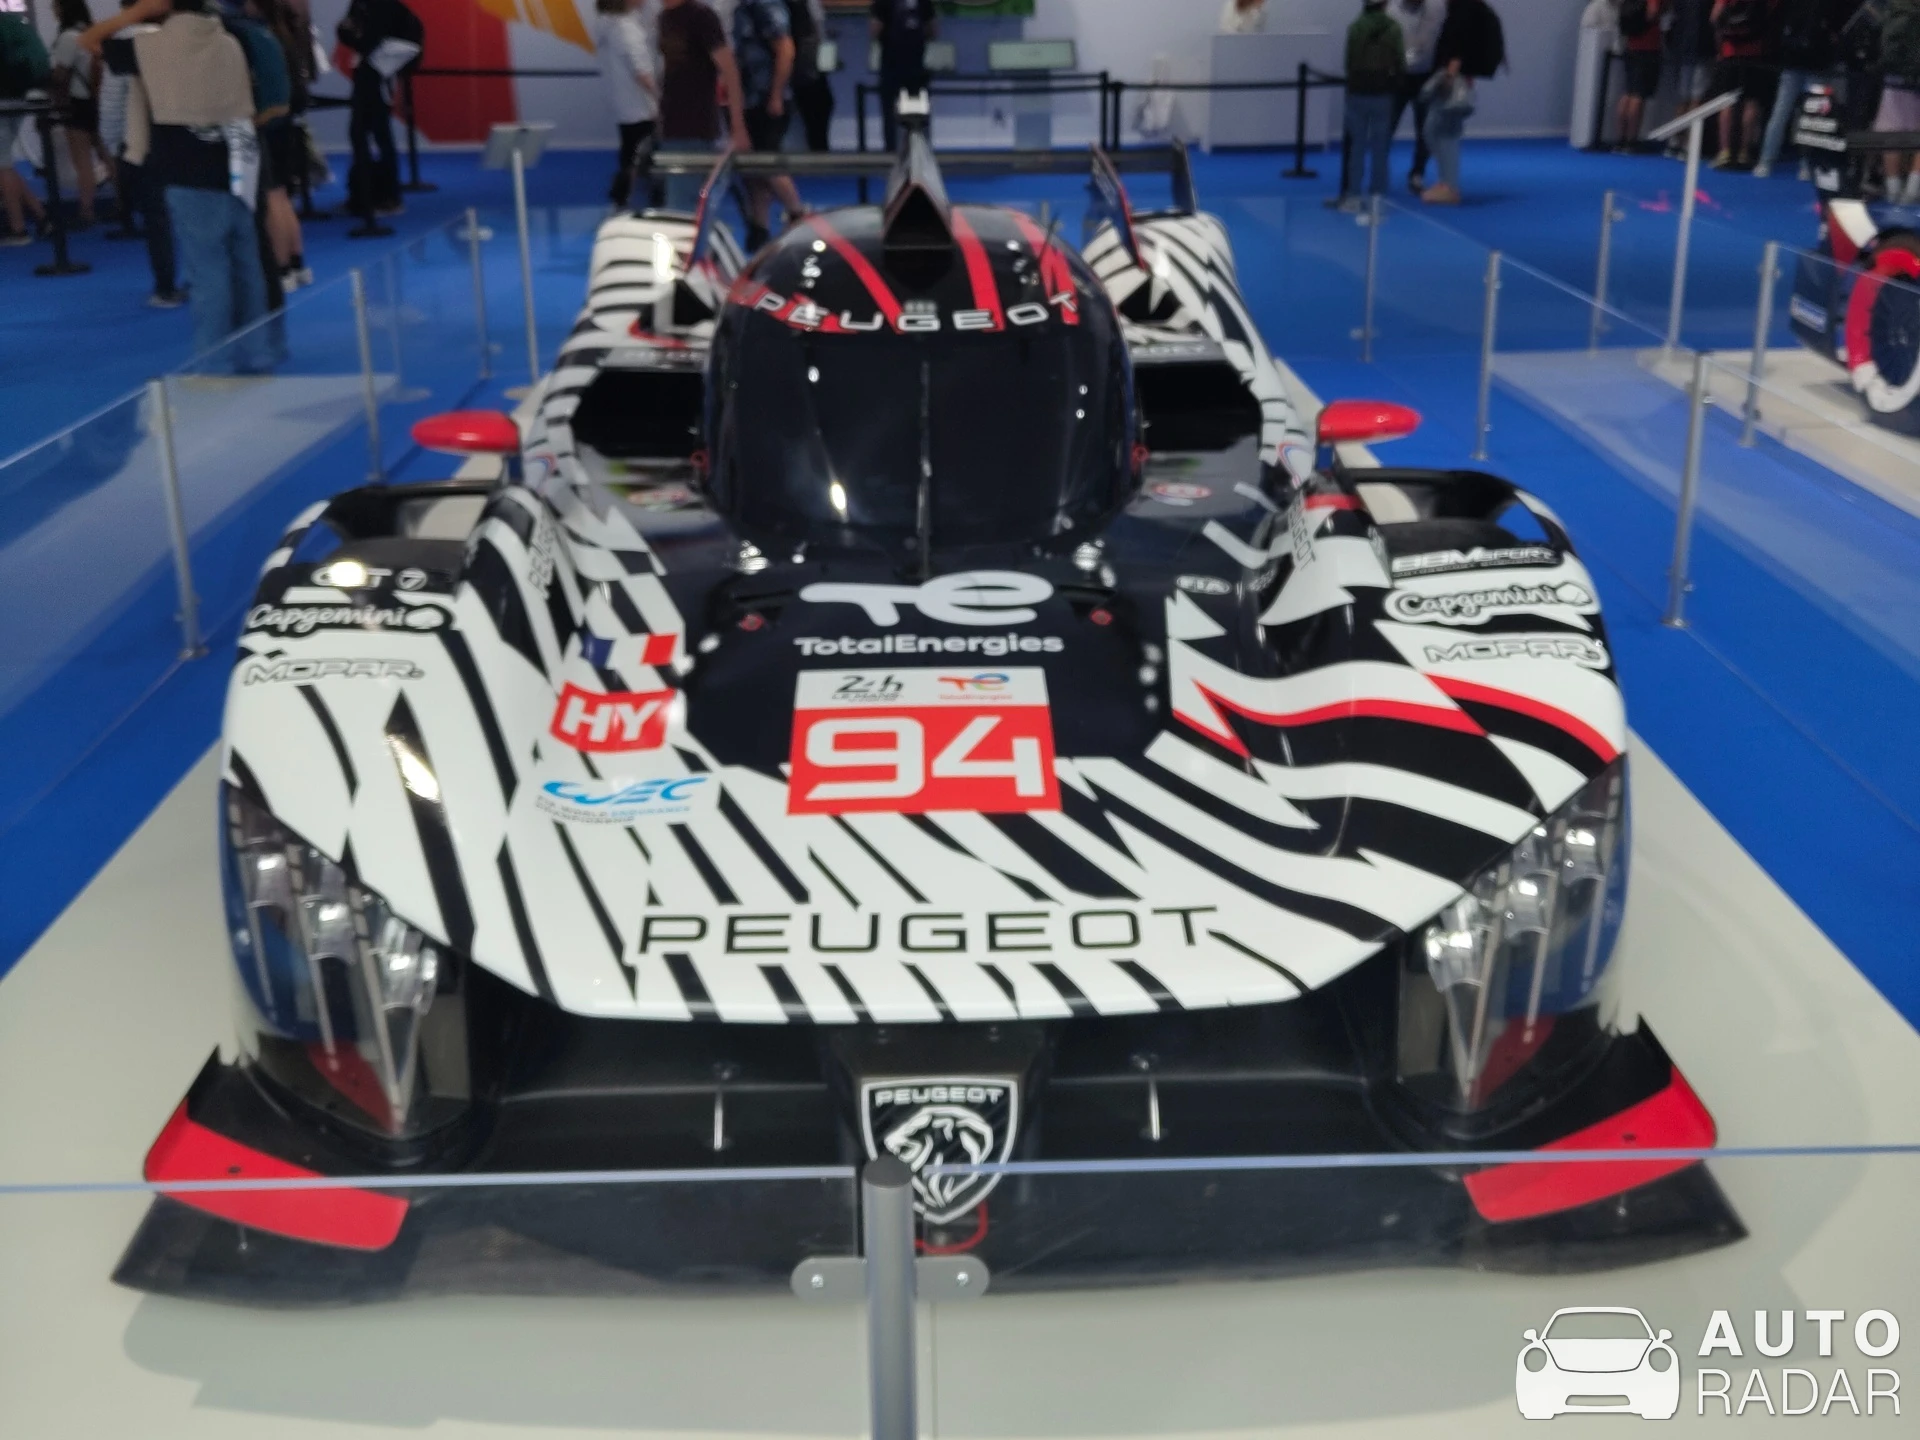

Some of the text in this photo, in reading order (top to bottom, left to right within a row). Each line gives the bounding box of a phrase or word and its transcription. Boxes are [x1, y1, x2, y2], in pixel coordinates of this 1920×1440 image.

[754, 291, 1077, 331] PEUGEOT
[249, 604, 406, 633] Capgemini
[1397, 584, 1559, 617] Capgemini
[793, 633, 1064, 656] TotalEnergies
[561, 695, 662, 743] HY
[805, 716, 1046, 800] 94
[638, 906, 1218, 954] PEUGEOT
[875, 1086, 1004, 1107] PEUGEOT
